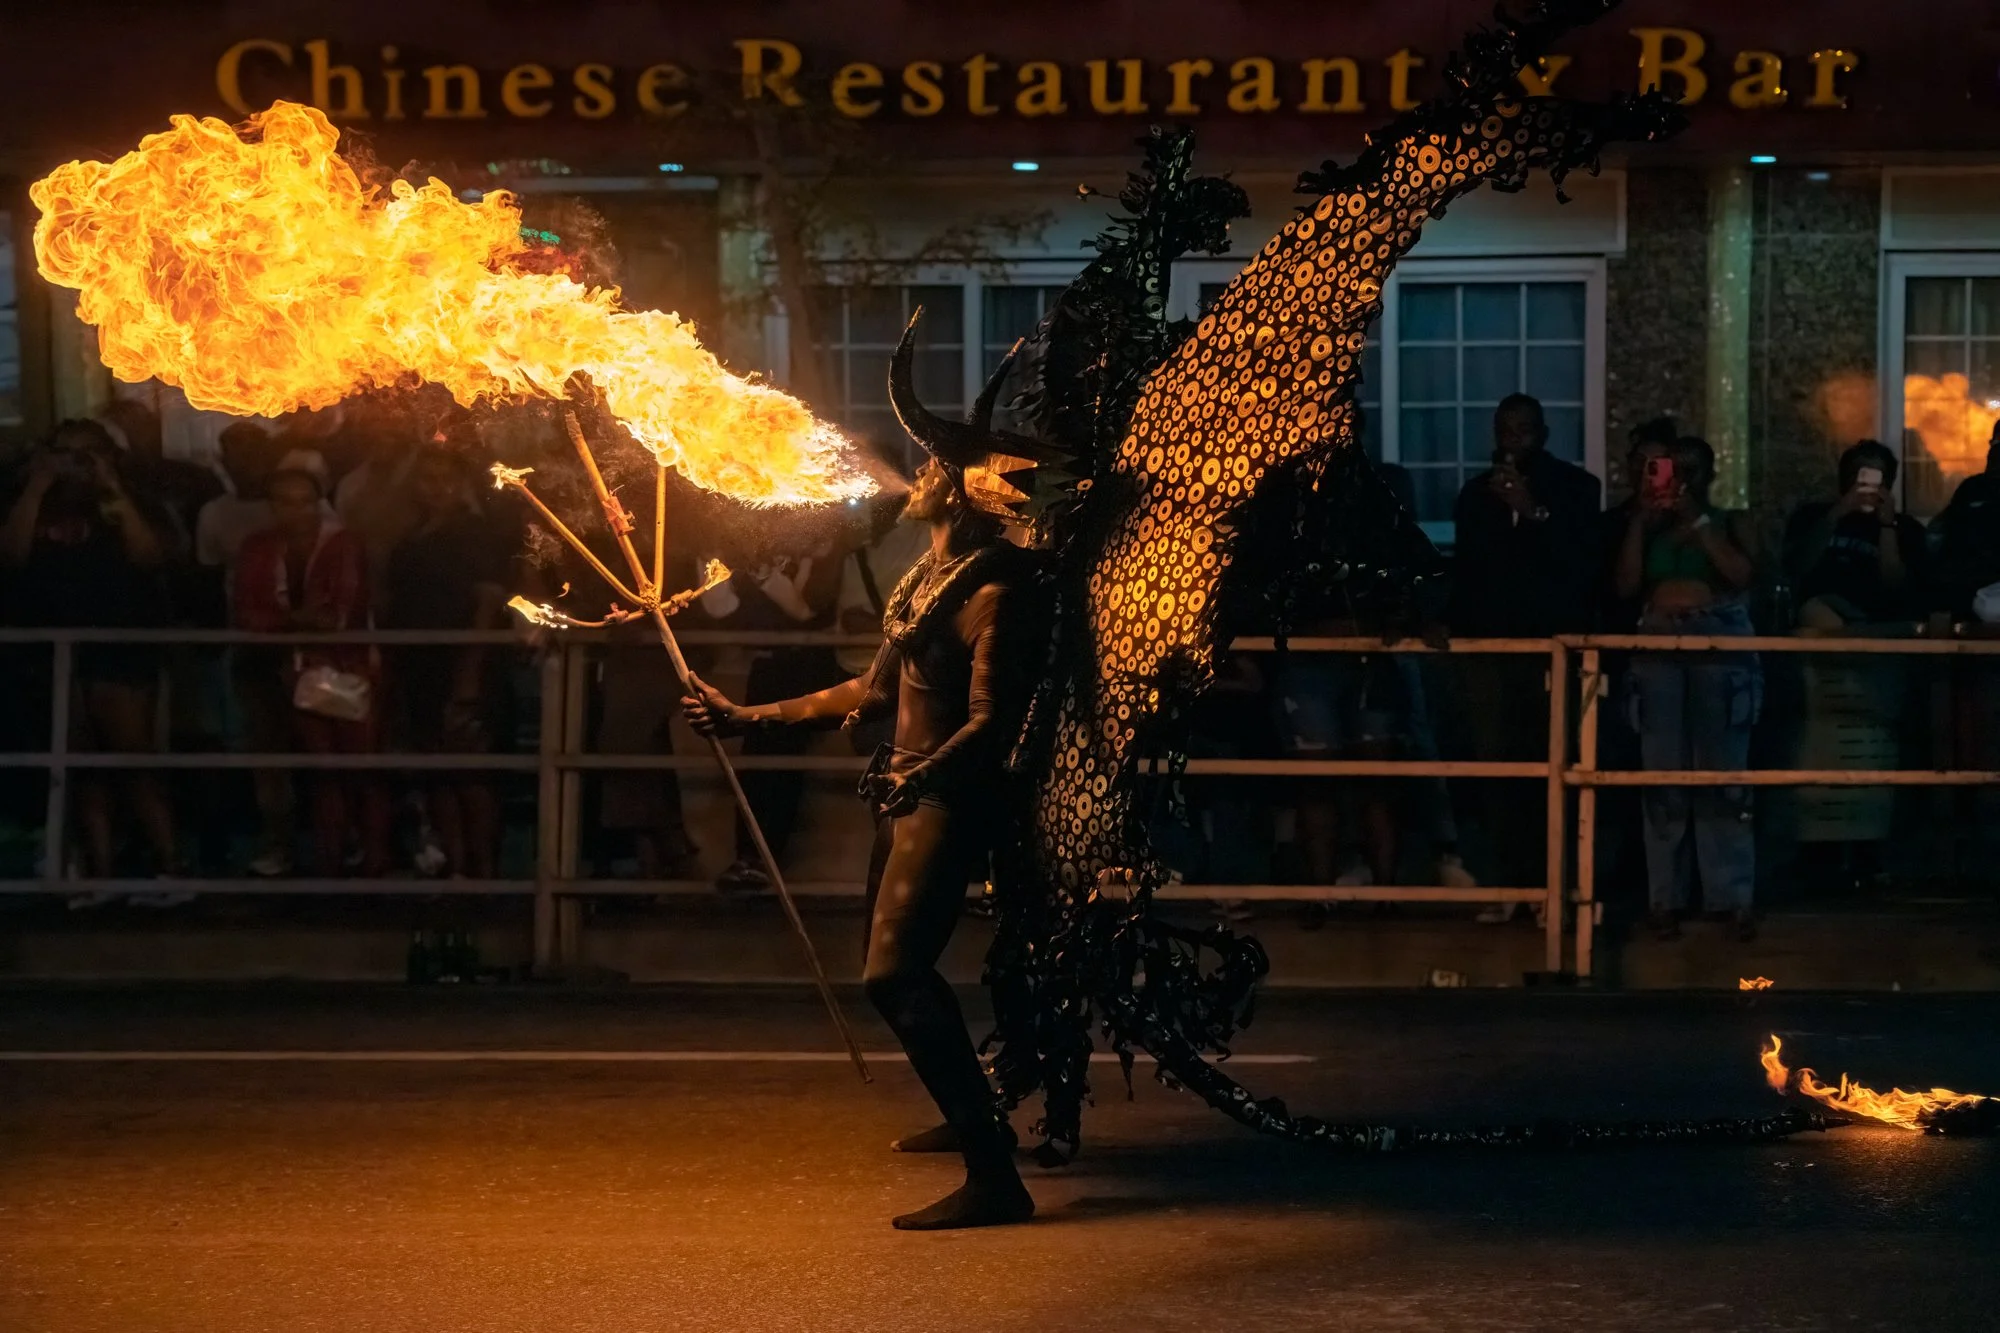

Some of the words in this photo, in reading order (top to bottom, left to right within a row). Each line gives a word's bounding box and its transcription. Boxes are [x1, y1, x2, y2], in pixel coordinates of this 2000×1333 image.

[215, 38, 690, 120] Chinese
[732, 37, 1426, 118] Restaurant
[1628, 26, 1860, 110] Bar
